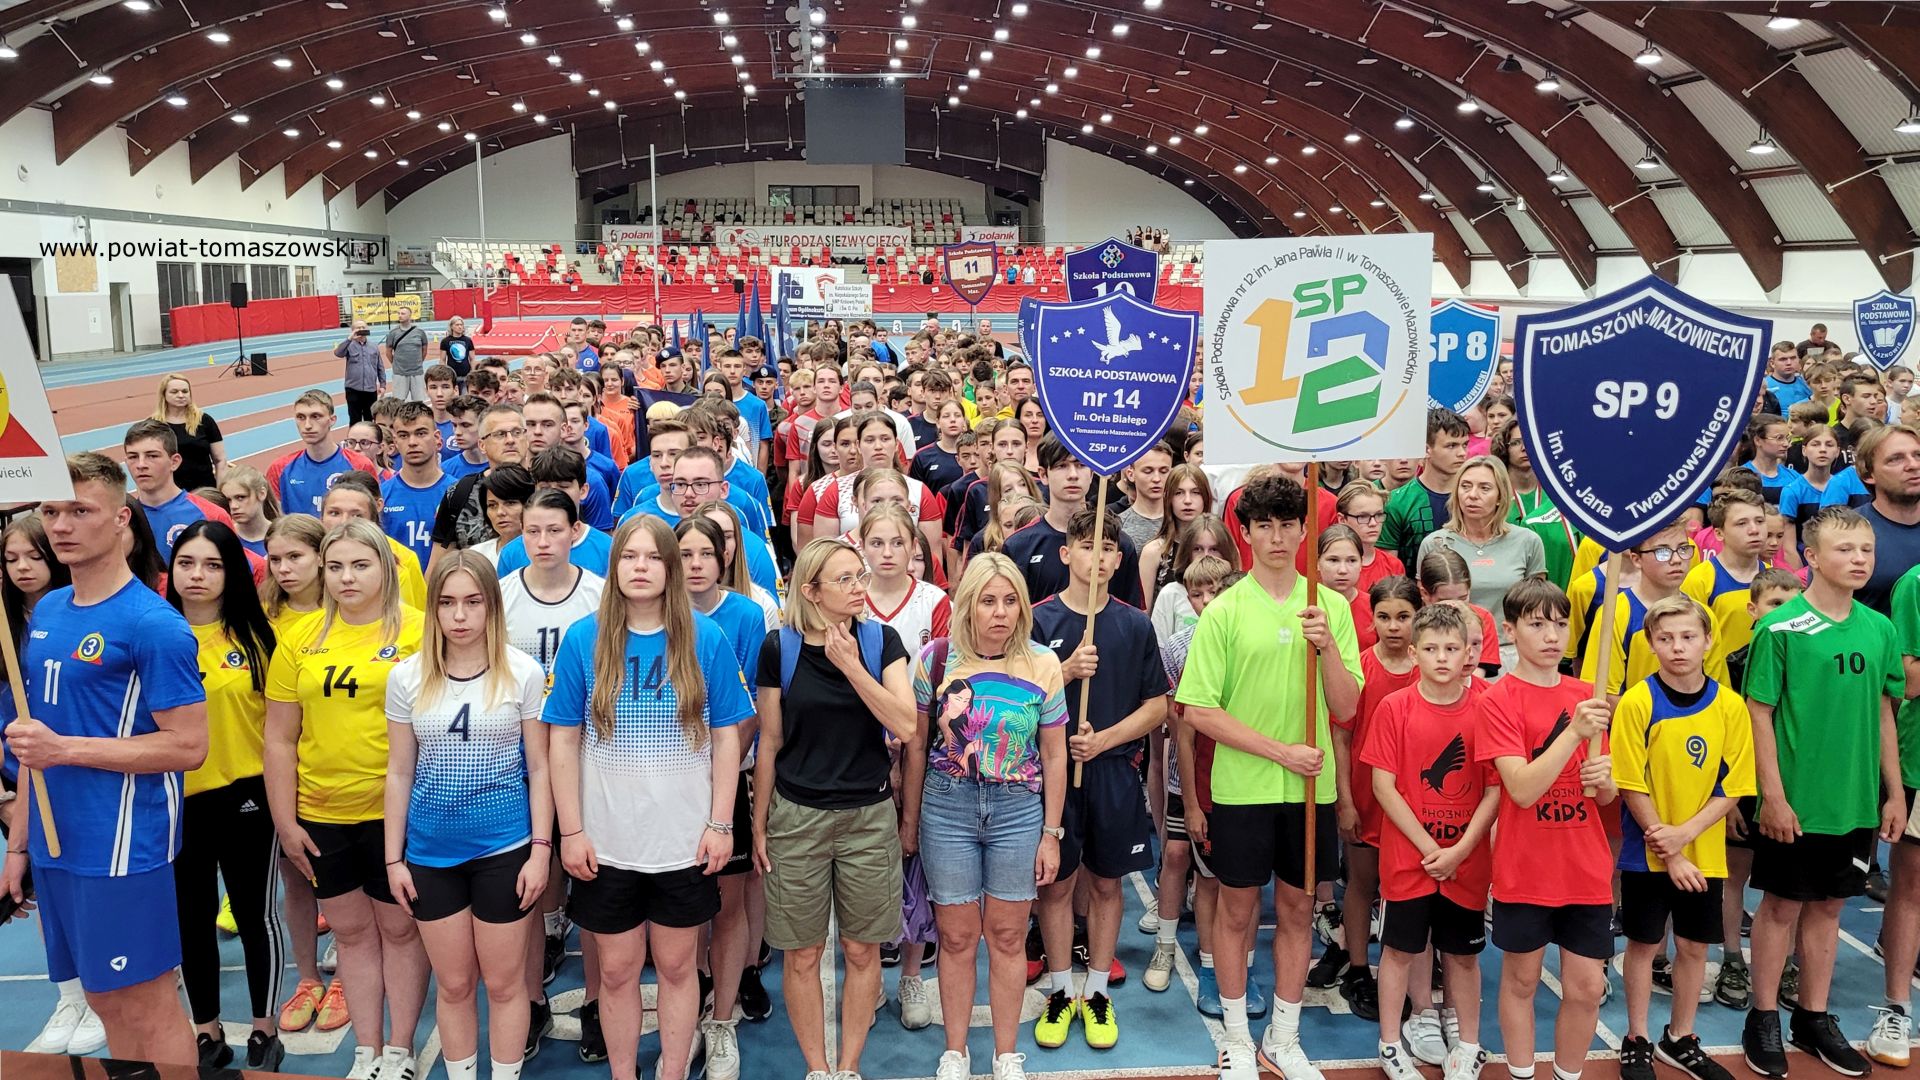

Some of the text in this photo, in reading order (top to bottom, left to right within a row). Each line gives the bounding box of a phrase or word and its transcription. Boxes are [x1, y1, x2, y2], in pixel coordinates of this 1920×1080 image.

[620, 230, 654, 240] polani
[978, 230, 1015, 240] polanik
[1274, 252, 1298, 268] Jana
[1299, 246, 1332, 260] Pawła
[1347, 252, 1357, 263] w
[964, 260, 978, 274] 11
[1252, 264, 1272, 278] im.
[1243, 273, 1257, 286] 12
[1360, 255, 1410, 310] Tomaszowie
[1235, 284, 1246, 296] nr
[1293, 274, 1368, 319] SP
[1860, 310, 1910, 320] PODSTAWOWA
[1872, 302, 1898, 310] SZKOŁA
[895, 323, 900, 332] 3
[1211, 297, 1239, 364] Podstawowa
[1401, 309, 1420, 384] Mazowieckim
[1466, 331, 1487, 361] 8
[1049, 367, 1177, 384] SZKOŁA PODSTAWOWA
[1213, 366, 1232, 400] Szkoła
[1083, 389, 1140, 409] nr 14
[1454, 370, 1488, 411] MAZOWIECKI
[1592, 380, 1679, 420] SP 9
[1074, 412, 1147, 426] im. Orła Białego
[1089, 443, 1107, 452] ZSP
[1120, 445, 1126, 453] 6
[1625, 396, 1732, 519] Twardowskiego
[1548, 430, 1613, 519] im. ks. Jana
[406, 520, 431, 547] 14
[1790, 615, 1816, 630] Kempa
[84, 639, 98, 655] 3
[385, 646, 392, 657] 3
[537, 627, 560, 664] 11
[231, 652, 241, 667] 3
[1833, 652, 1866, 674] 10
[44, 659, 62, 705] 11
[323, 666, 358, 698] 14
[628, 656, 662, 700] 14
[447, 703, 471, 742] 4
[1686, 735, 1708, 769] 9
[1536, 801, 1587, 822] KiDS
